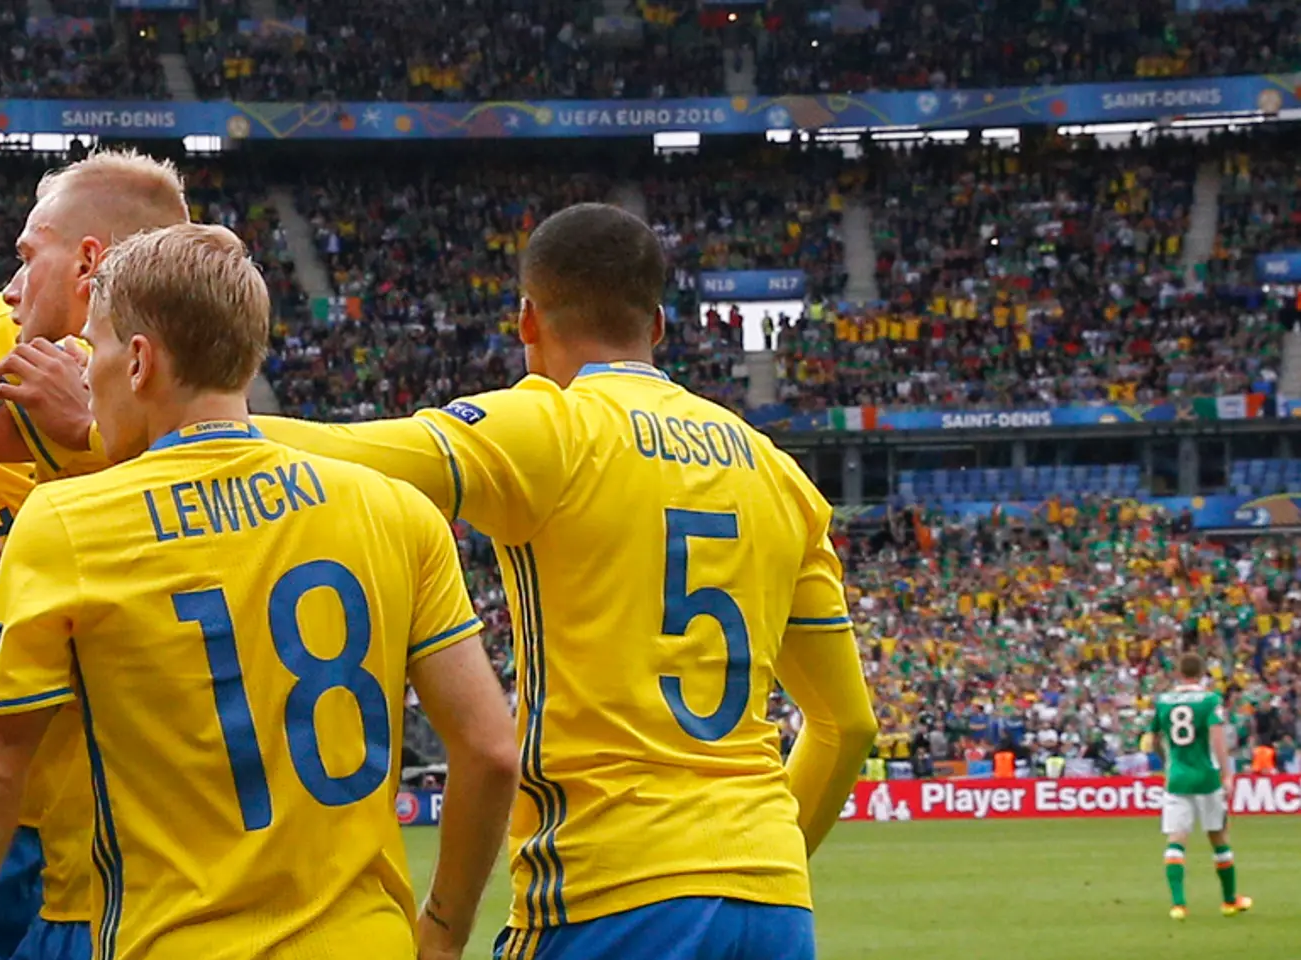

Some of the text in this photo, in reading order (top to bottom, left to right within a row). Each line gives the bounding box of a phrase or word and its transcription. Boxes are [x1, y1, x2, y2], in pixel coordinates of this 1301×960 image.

[559, 107, 726, 126] UEFA EURO 2016
[1101, 88, 1222, 110] SAINT-DENIS
[61, 110, 176, 128] SAINT-DENIS
[769, 278, 798, 290] N17
[942, 411, 1053, 428] SAINT-DENIS
[630, 409, 756, 470] OLSSON
[144, 461, 328, 543] LEWICKI
[658, 507, 752, 742] 5
[172, 559, 391, 832] 18
[1170, 705, 1195, 746] 8
[921, 781, 1164, 818] Player Escorts
